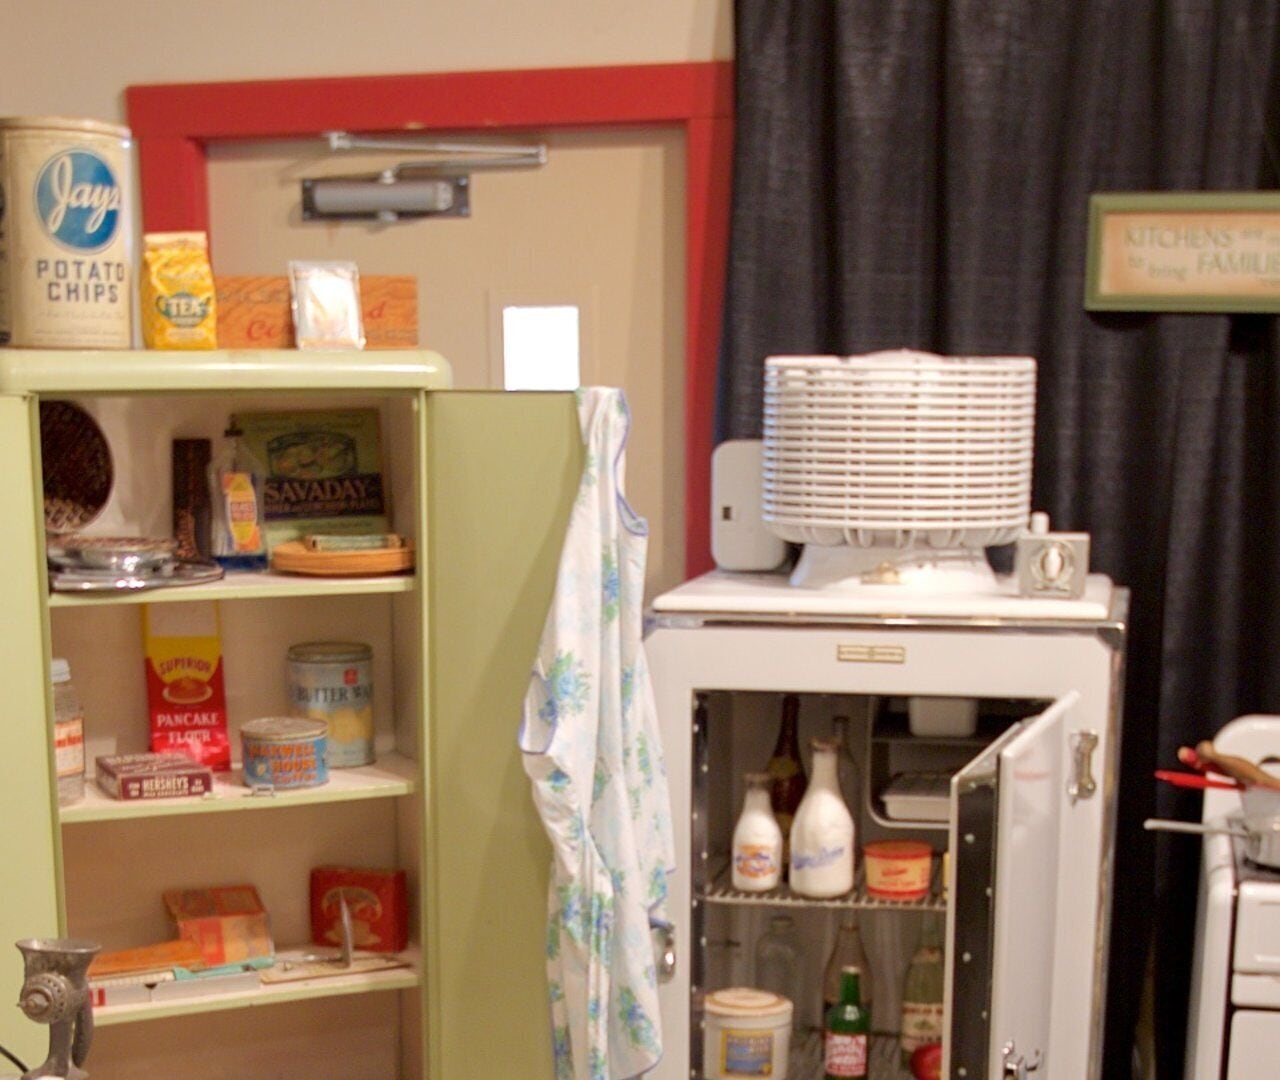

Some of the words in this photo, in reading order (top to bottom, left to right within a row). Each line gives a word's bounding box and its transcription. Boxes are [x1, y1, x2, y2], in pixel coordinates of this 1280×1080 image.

[1124, 226, 1233, 248] KITCHENS
[37, 259, 125, 281] POTATO
[48, 282, 119, 303] CHIPS
[169, 298, 204, 317] TEA
[264, 479, 368, 503] SAVADAY
[295, 687, 348, 703] BUTTER
[156, 712, 220, 727] PANCAKE
[167, 729, 211, 745] FLOUR
[271, 757, 317, 772] HOUSE
[142, 776, 189, 792] HERSHEY'S
